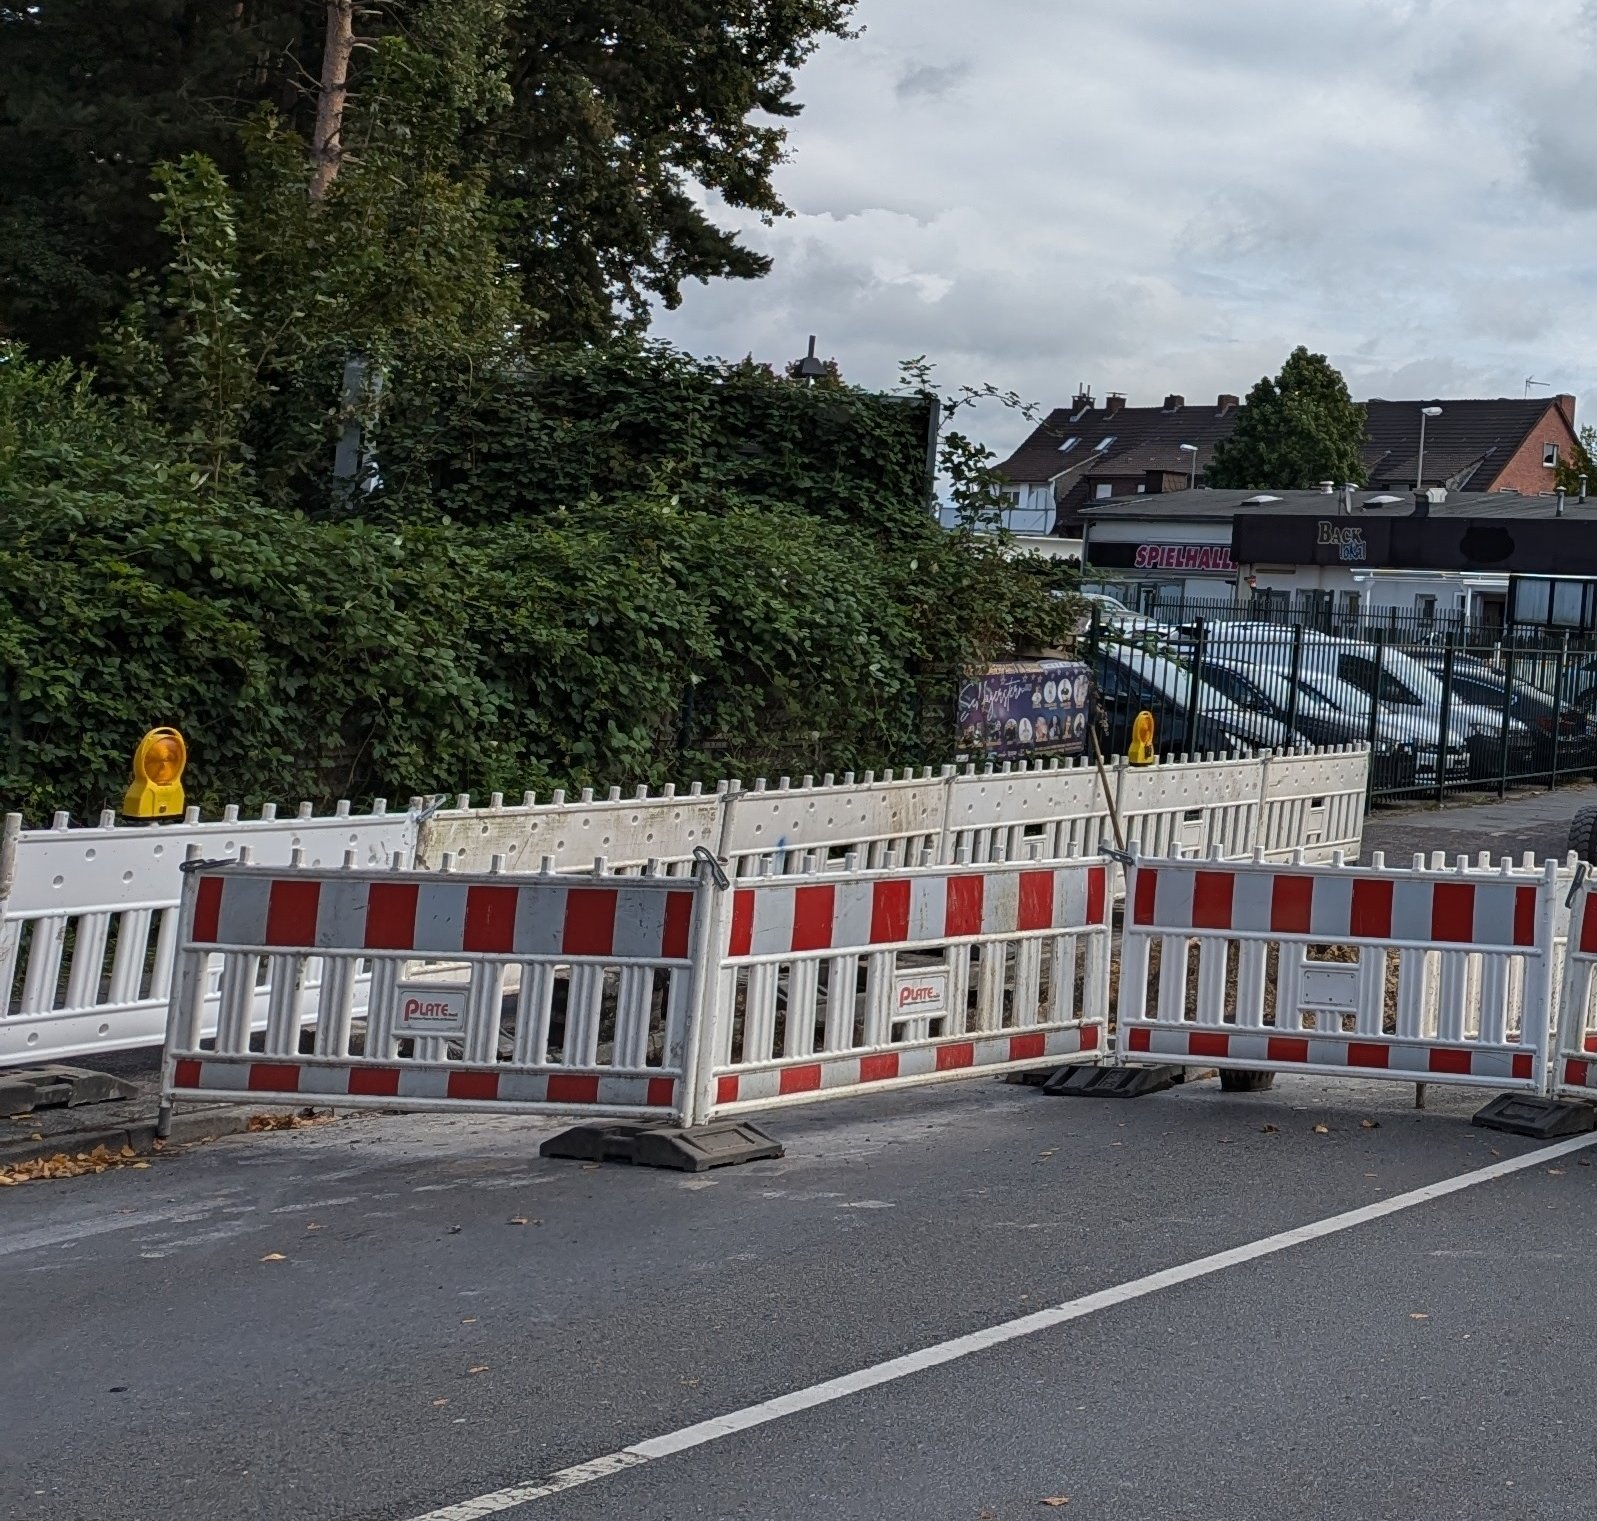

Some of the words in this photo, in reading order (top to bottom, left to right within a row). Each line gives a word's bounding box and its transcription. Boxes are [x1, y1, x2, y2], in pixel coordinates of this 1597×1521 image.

[1134, 544, 1237, 572] SPIELHALL
[899, 987, 934, 1008] PLATE
[404, 999, 449, 1021] PLATE
